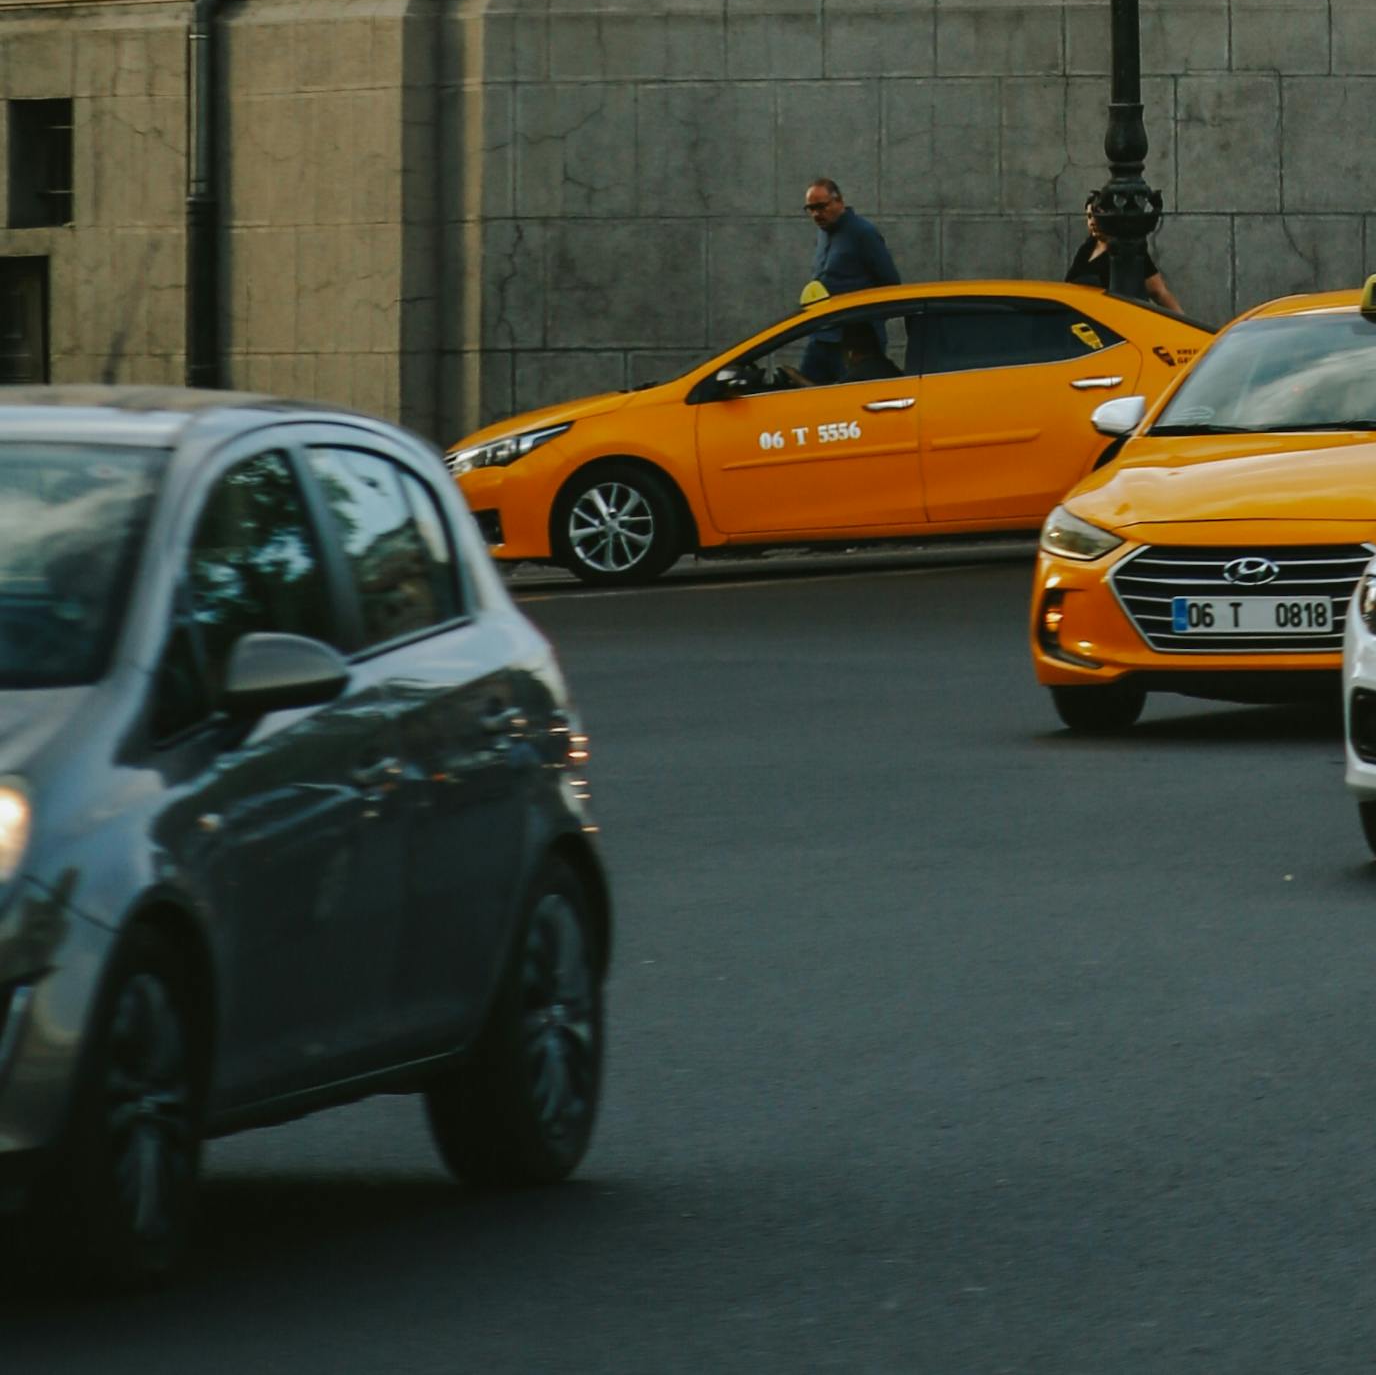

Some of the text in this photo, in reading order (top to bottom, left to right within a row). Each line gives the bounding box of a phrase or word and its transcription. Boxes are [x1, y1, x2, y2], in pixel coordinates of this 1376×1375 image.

[759, 420, 862, 450] 06 T 5556
[1188, 602, 1328, 628] 06 T 0818
